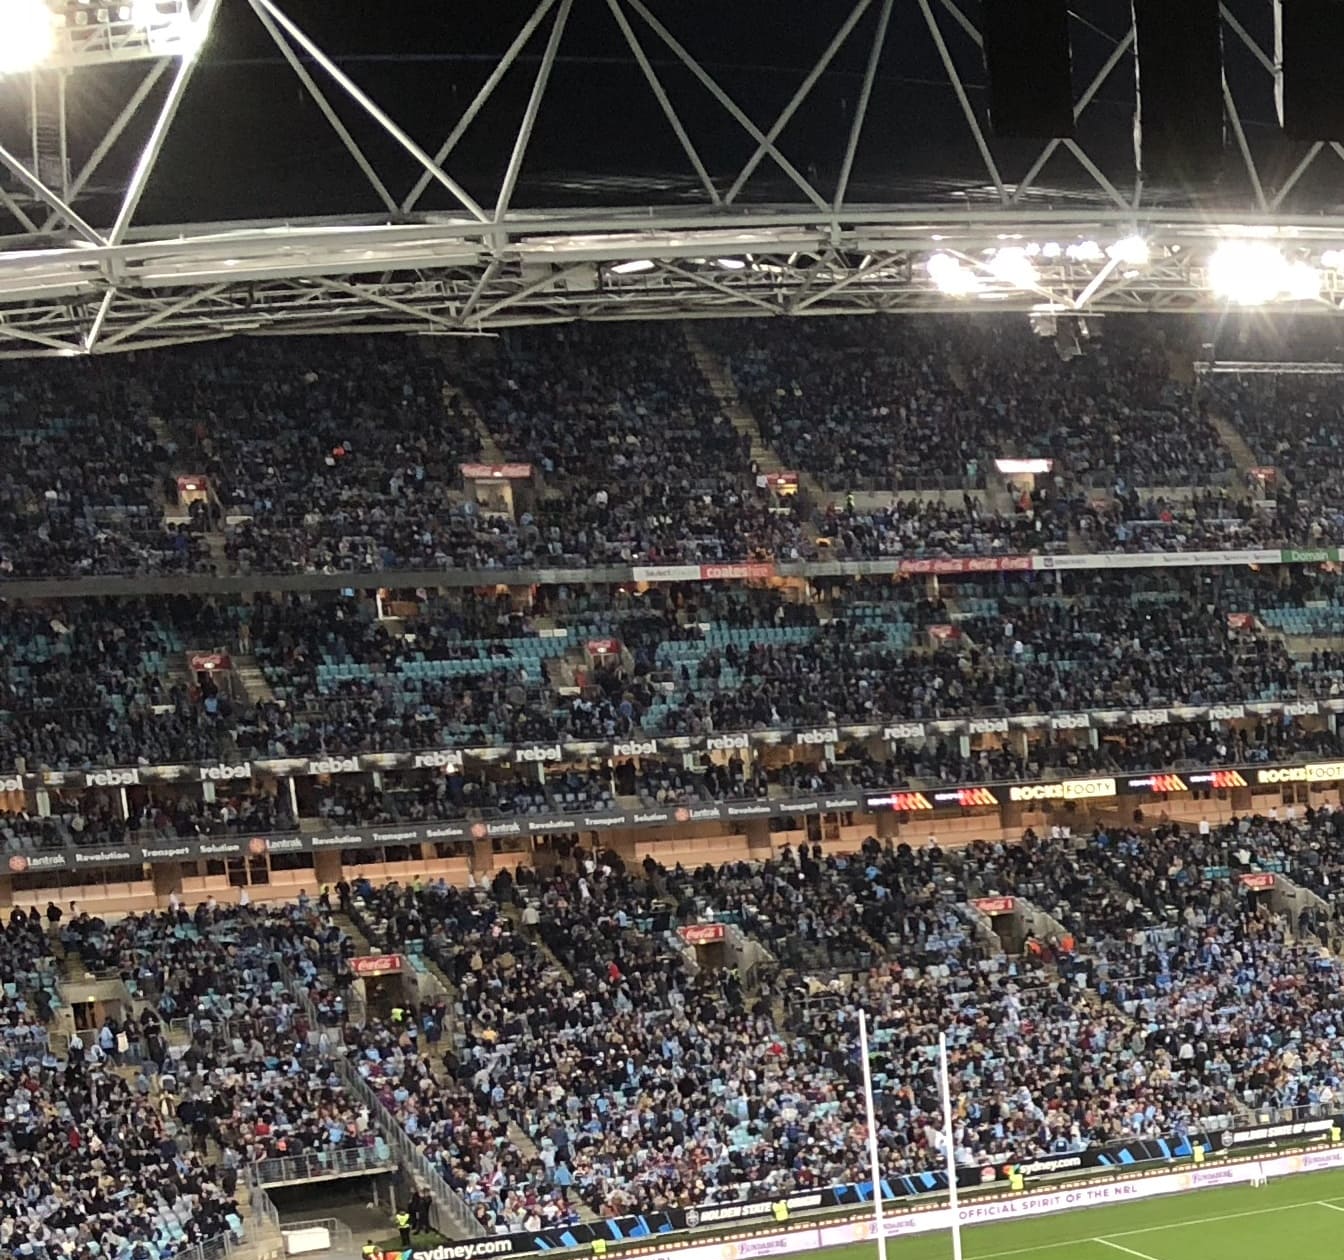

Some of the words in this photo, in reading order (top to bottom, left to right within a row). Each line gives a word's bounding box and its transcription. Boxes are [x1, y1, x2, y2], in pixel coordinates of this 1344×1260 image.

[1291, 552, 1329, 561] Domain
[1208, 704, 1244, 720] rebel
[1284, 701, 1319, 716] rebel
[969, 718, 1008, 734] rebel
[1052, 714, 1090, 730] rebel
[707, 734, 749, 750] rebel
[797, 729, 838, 744] rebel
[416, 750, 462, 767] rebel
[516, 745, 562, 762] rebel
[86, 768, 139, 787] rebel
[200, 762, 251, 780] rebel
[1010, 784, 1063, 801] ROCKS
[1066, 782, 1113, 796] FOOTY
[27, 853, 66, 866] Lantrak
[76, 850, 130, 863] Revolution
[142, 846, 190, 858] Transport
[200, 842, 240, 854] Solution
[358, 958, 392, 970] Coca-Cola
[1020, 1156, 1082, 1176] sydney.com
[958, 1204, 1019, 1220] OFFICIAL
[1022, 1196, 1062, 1211] SPIRIT
[1066, 1192, 1082, 1204] OF
[1087, 1188, 1111, 1200] THE
[1114, 1184, 1138, 1196] NRL
